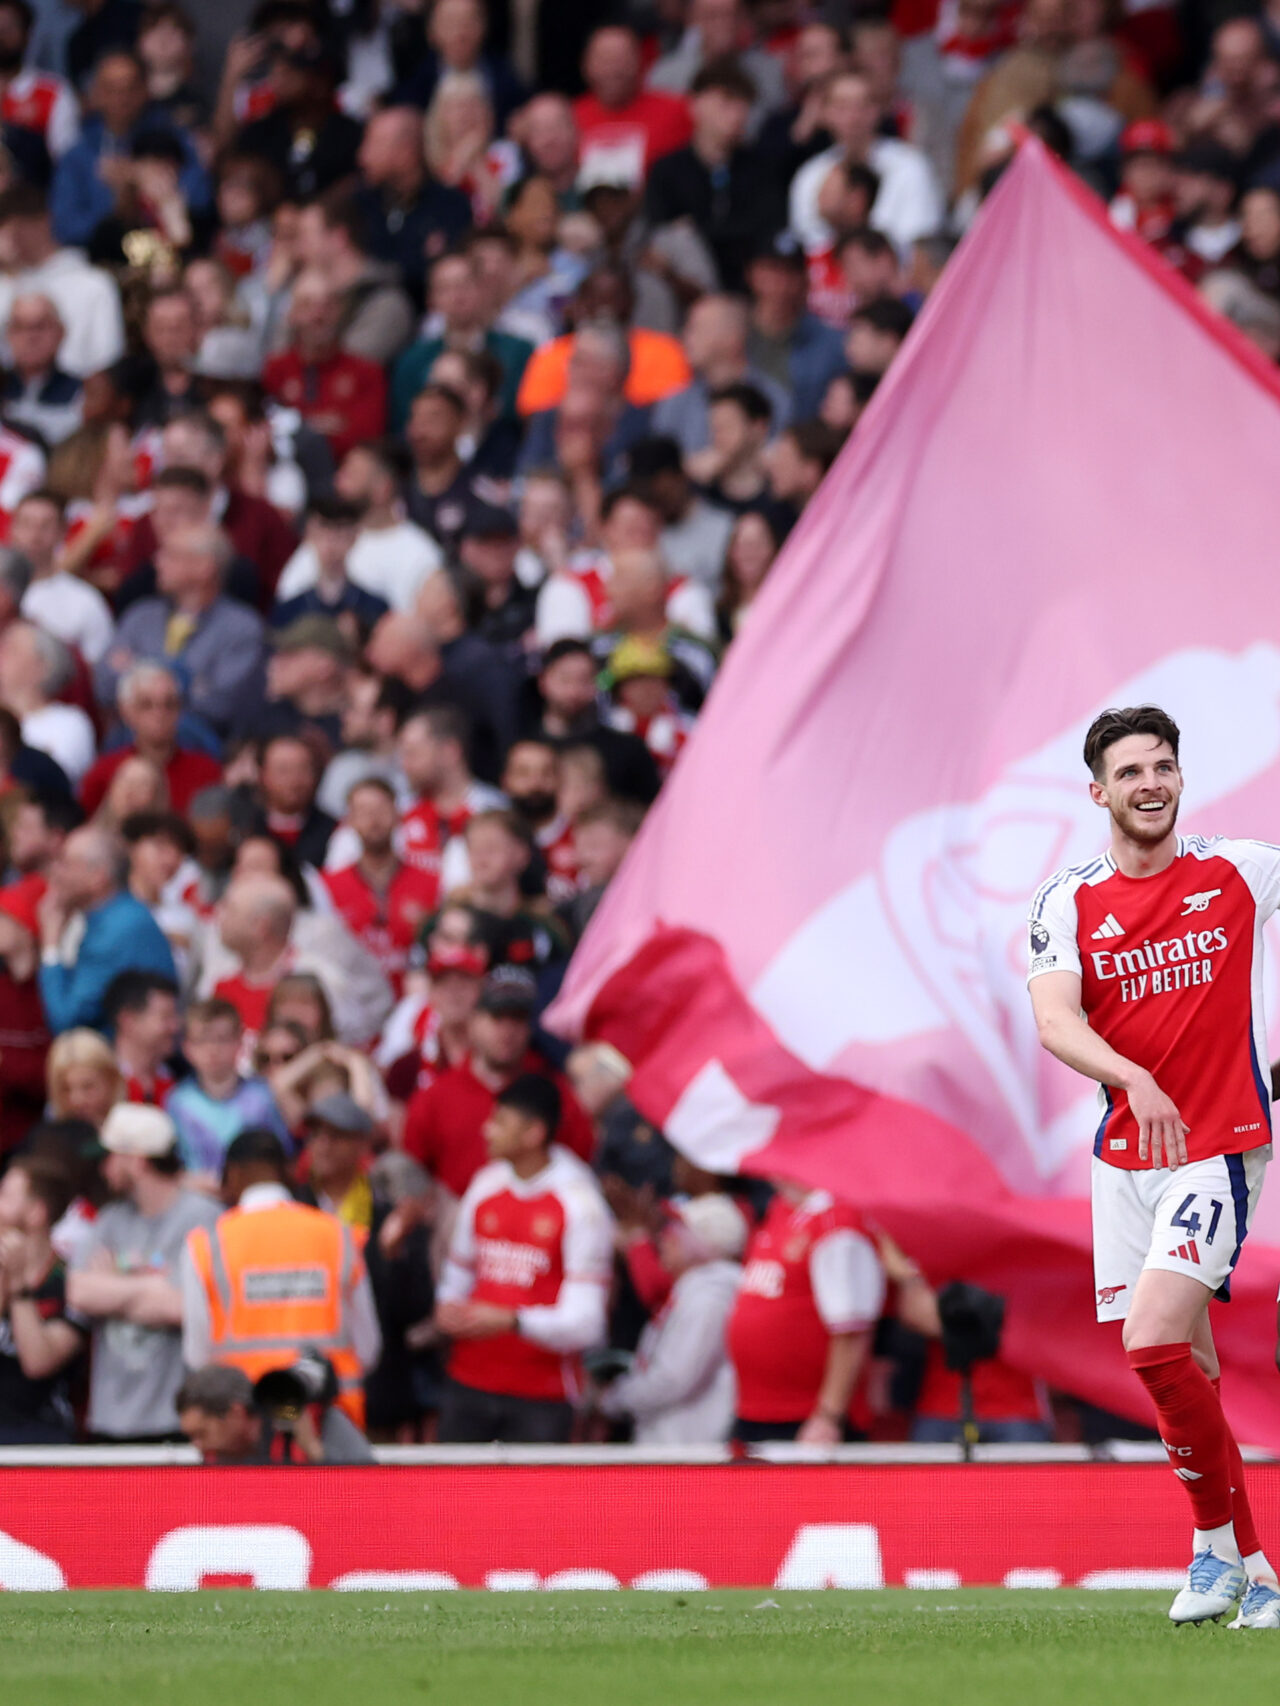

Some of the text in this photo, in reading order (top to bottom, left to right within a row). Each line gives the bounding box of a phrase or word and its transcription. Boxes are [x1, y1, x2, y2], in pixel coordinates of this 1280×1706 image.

[1090, 927, 1228, 981] Emirates
[1121, 959, 1213, 1003] FLY BETTER
[1170, 1193, 1223, 1246] 41
